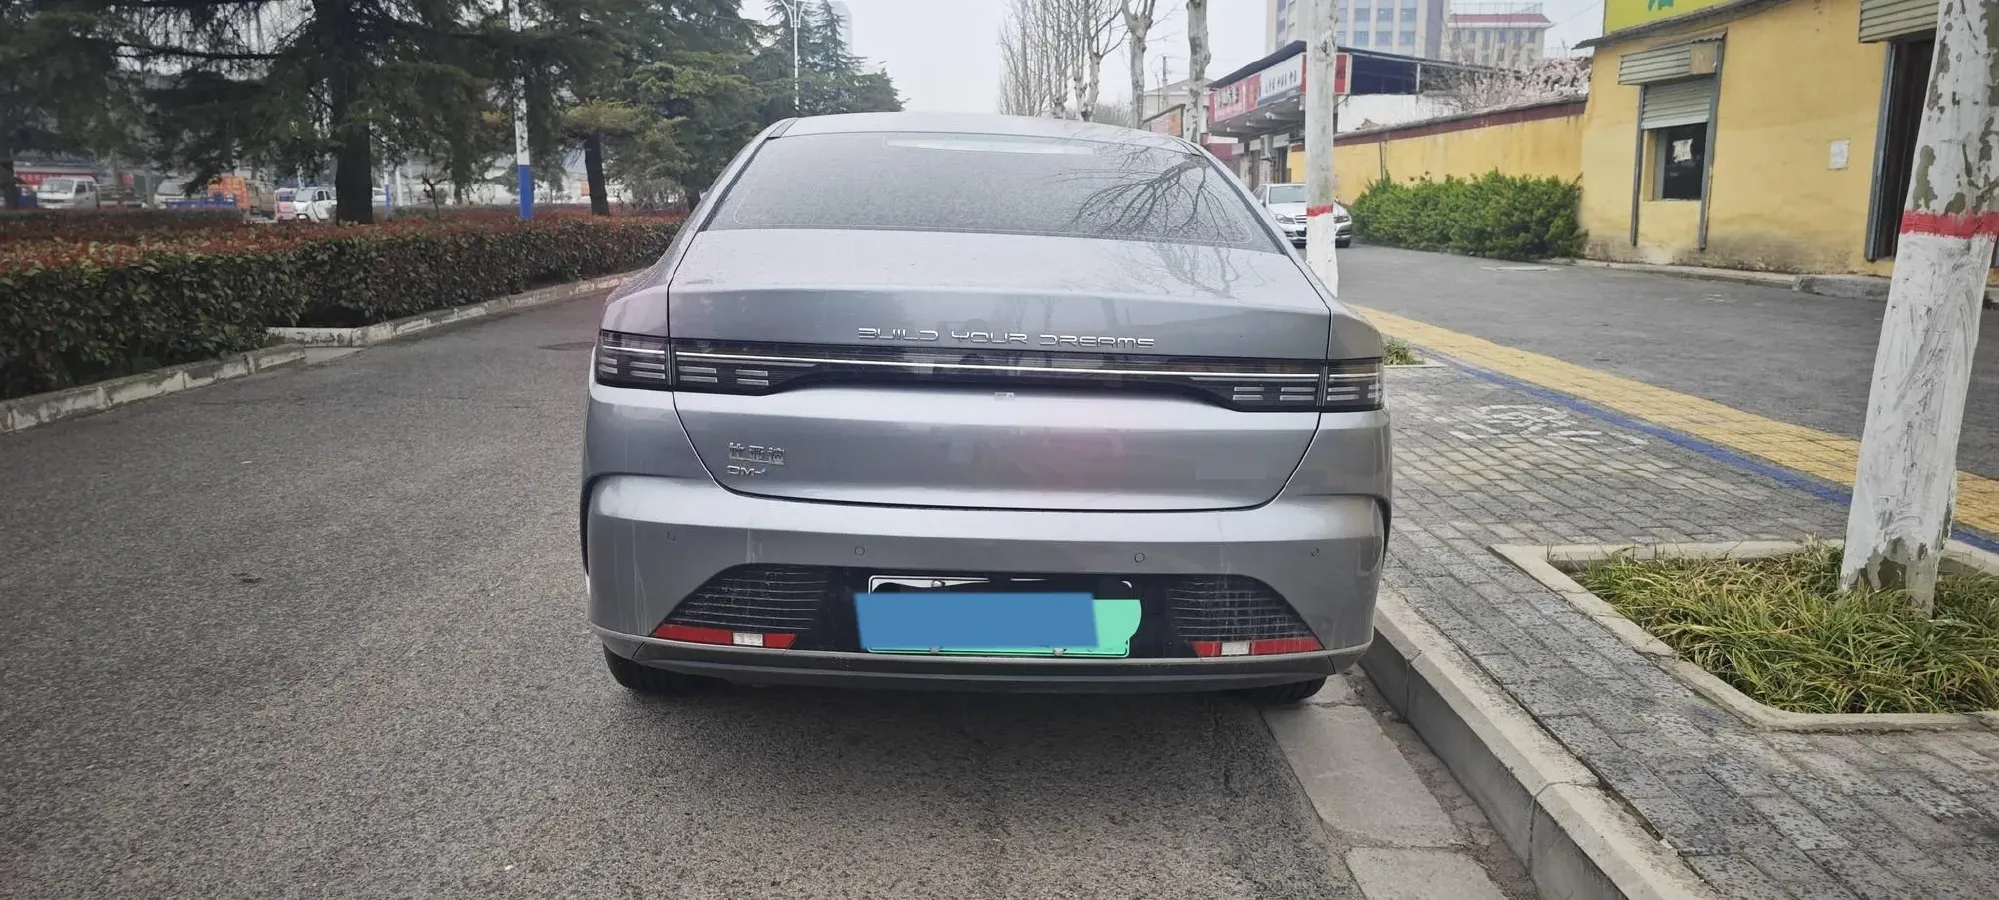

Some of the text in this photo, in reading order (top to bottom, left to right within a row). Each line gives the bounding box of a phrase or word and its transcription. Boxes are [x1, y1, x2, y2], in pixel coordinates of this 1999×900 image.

[858, 327, 1156, 348] BUILD YOUR DREAMS
[729, 442, 785, 465] 比亚迪
